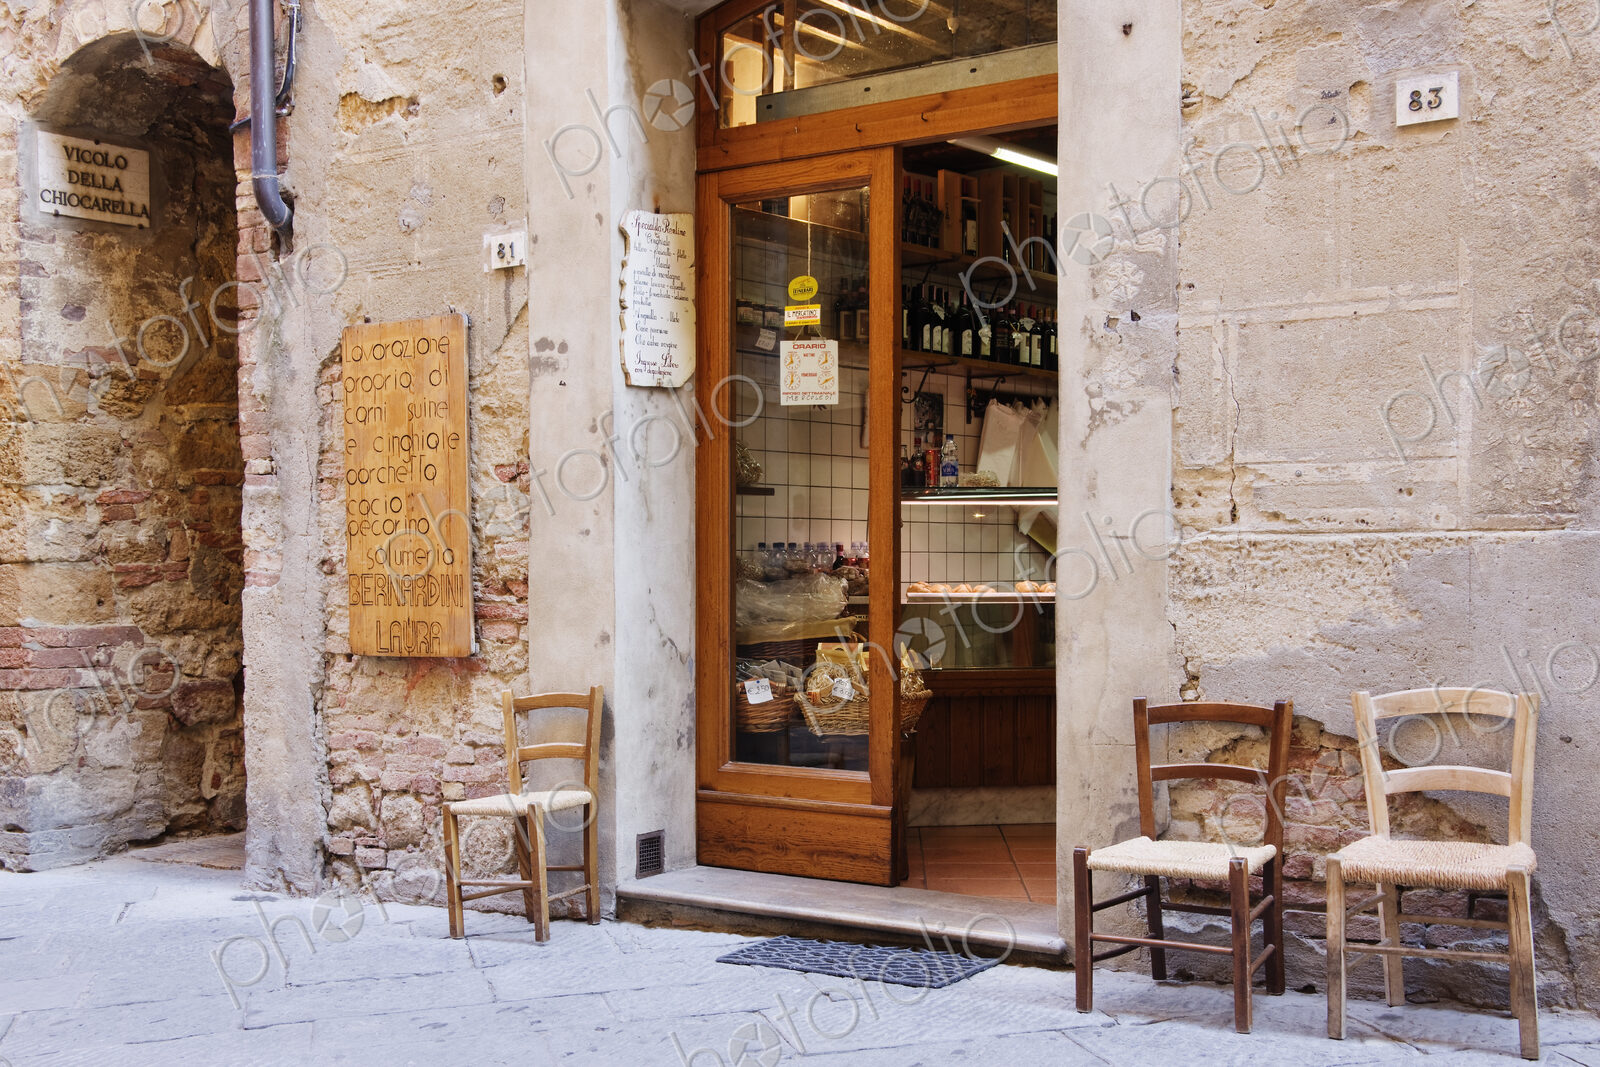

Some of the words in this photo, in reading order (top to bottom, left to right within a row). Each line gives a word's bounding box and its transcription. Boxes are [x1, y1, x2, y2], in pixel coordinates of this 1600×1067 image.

[1408, 86, 1444, 112] 83
[63, 145, 128, 170] VICOLO
[68, 170, 124, 193] DELLA
[40, 189, 150, 219] CHIOCARELLA
[497, 241, 515, 259] 81
[345, 401, 387, 425] carni
[408, 397, 449, 421] suine
[345, 438, 357, 455] e
[373, 423, 460, 463] cinghiale
[347, 495, 403, 517] cacio
[347, 515, 430, 550] pecorino
[367, 539, 454, 570] salumeria
[349, 573, 464, 607] BERNARDINI
[376, 618, 442, 654] LAURA
